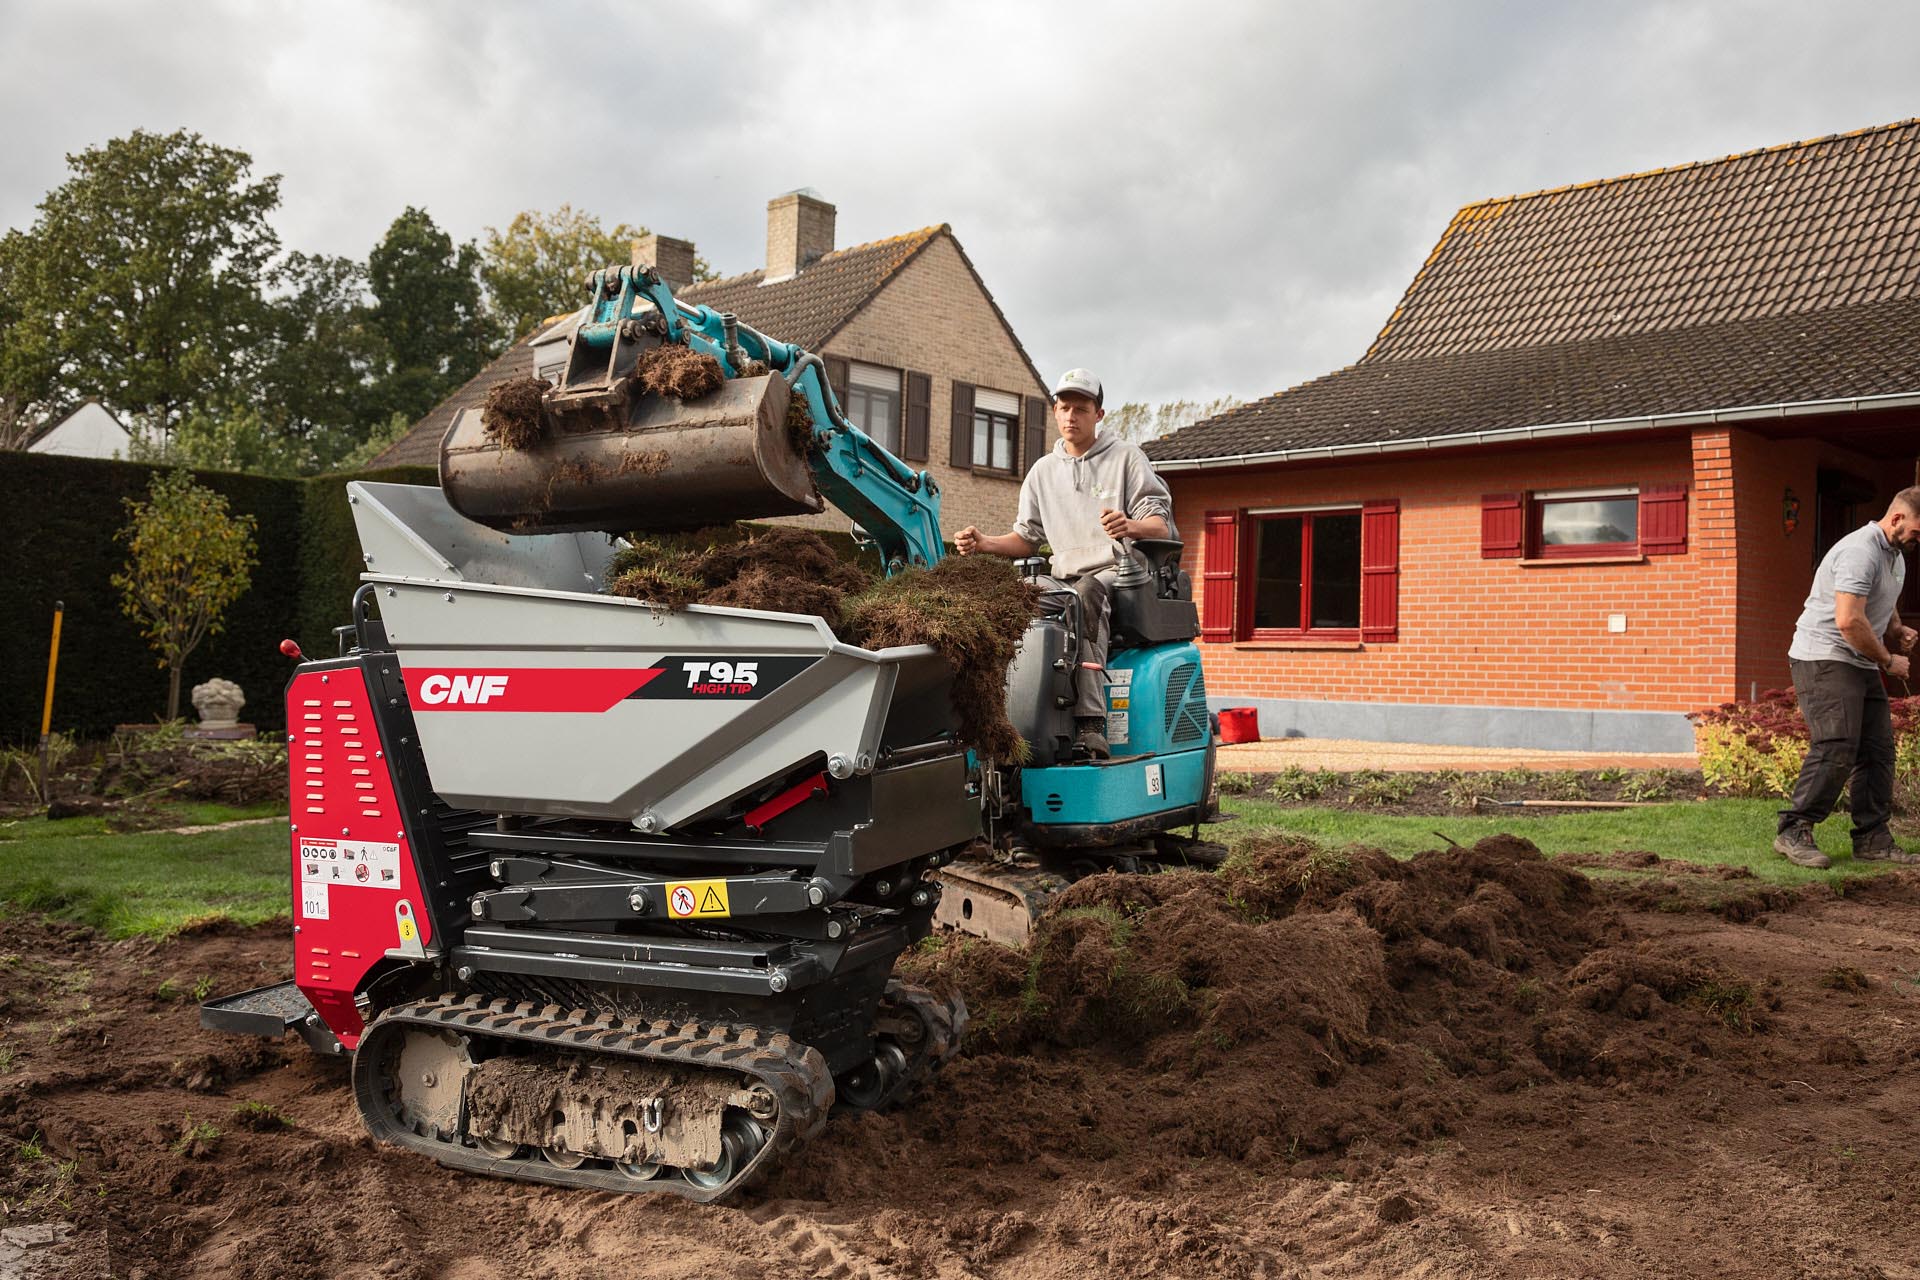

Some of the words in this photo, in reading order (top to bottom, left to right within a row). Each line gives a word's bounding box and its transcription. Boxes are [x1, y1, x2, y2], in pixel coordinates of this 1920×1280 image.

[682, 661, 759, 689] T95
[420, 674, 509, 705] CNF
[692, 683, 728, 695] HIGH
[729, 683, 752, 695] TIP
[1151, 777, 1160, 792] 93
[304, 900, 320, 915] 101
